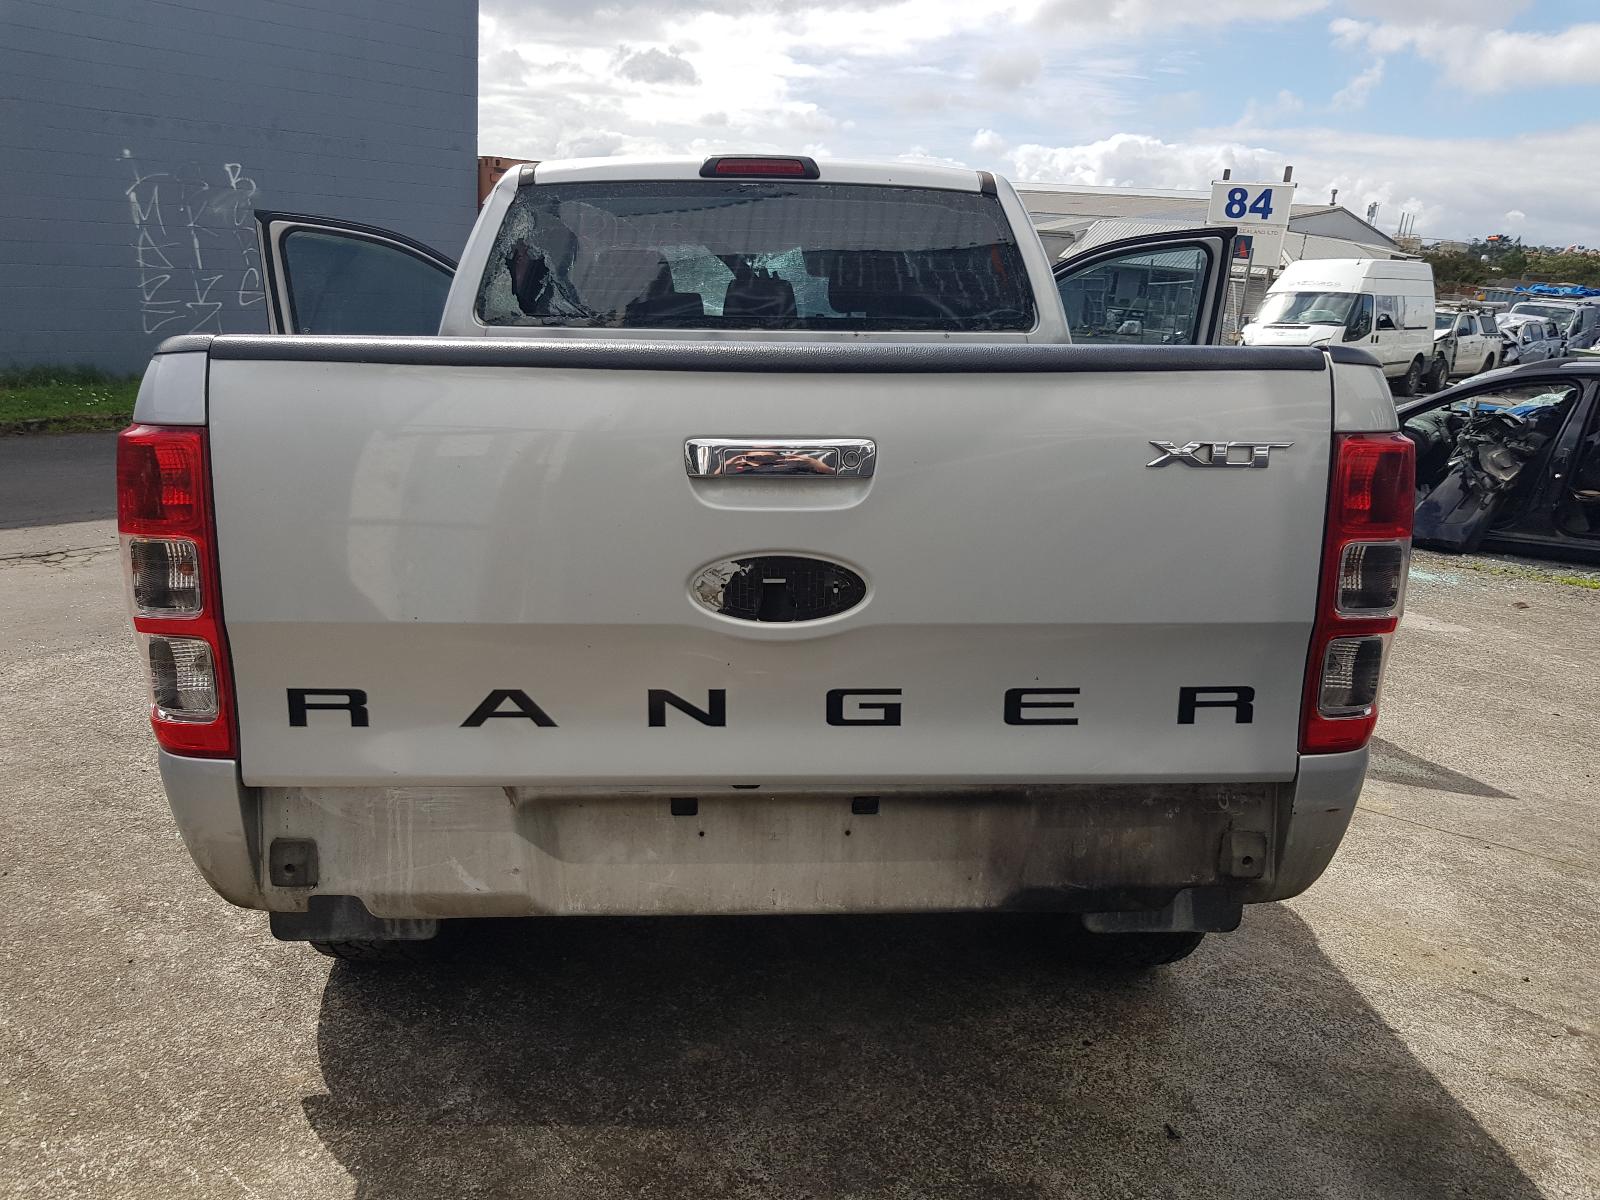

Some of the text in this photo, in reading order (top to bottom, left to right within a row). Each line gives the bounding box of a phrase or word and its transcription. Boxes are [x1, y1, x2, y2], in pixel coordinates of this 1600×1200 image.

[1225, 188, 1273, 220] 84
[1146, 440, 1295, 468] XLT
[286, 686, 1256, 727] RANGER
